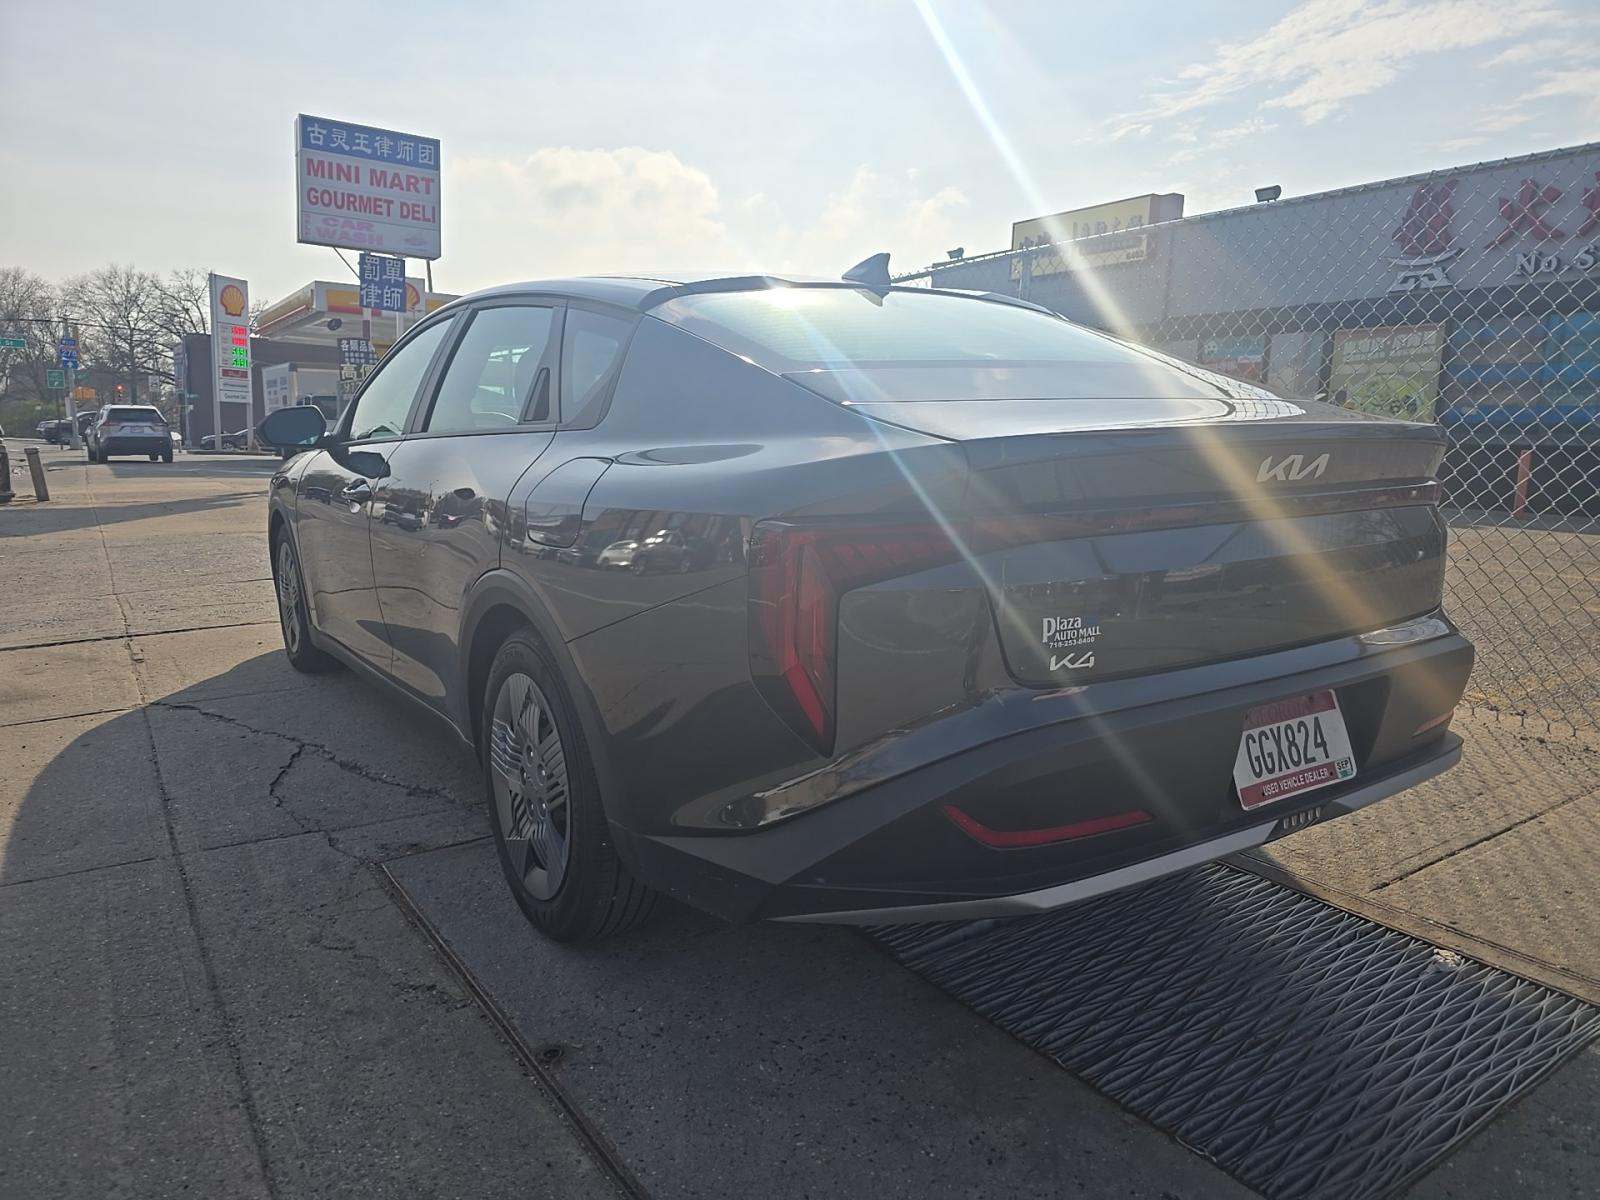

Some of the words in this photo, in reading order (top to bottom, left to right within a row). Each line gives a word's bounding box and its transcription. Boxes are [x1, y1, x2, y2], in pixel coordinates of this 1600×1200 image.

[307, 123, 435, 166] 古灵王律师团
[306, 158, 360, 184] MINI
[369, 167, 434, 195] MART
[307, 187, 394, 217] GOURMET
[400, 201, 436, 223] DELI
[363, 256, 403, 283] 罰單
[361, 283, 403, 310] 律師
[1042, 616, 1082, 643] Plaza
[1054, 629, 1077, 641] AUTO
[1078, 625, 1102, 638] MALL
[1049, 651, 1095, 671] K4
[1245, 716, 1330, 779] GGX824
[1336, 758, 1350, 770] SEP
[1262, 782, 1279, 796] USED
[1279, 775, 1305, 791] VEHICLE
[1305, 768, 1329, 784] DEALER
